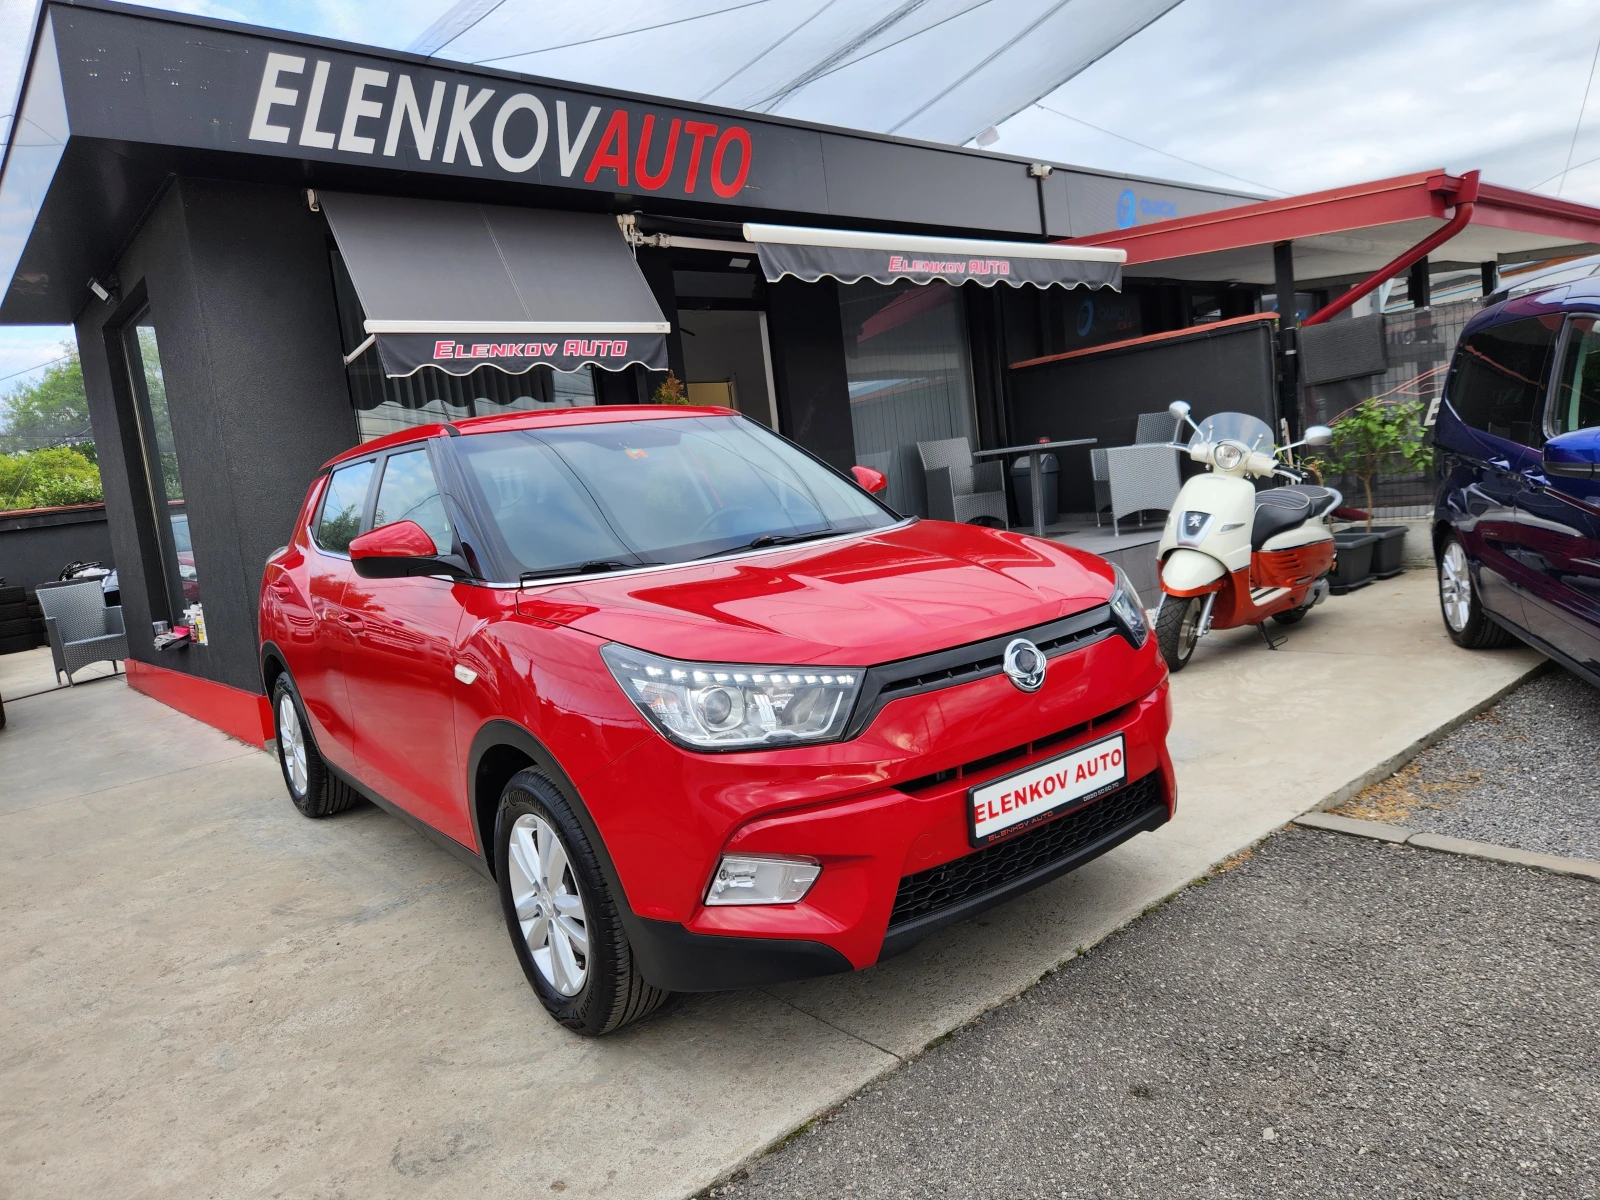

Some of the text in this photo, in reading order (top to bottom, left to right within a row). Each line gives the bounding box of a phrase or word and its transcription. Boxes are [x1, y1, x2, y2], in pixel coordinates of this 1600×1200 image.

[968, 260, 1010, 275] AUTO
[563, 340, 628, 357] AUTO
[974, 748, 1122, 825] ELENKOV AUTO
[1031, 810, 1054, 824] AUTO
